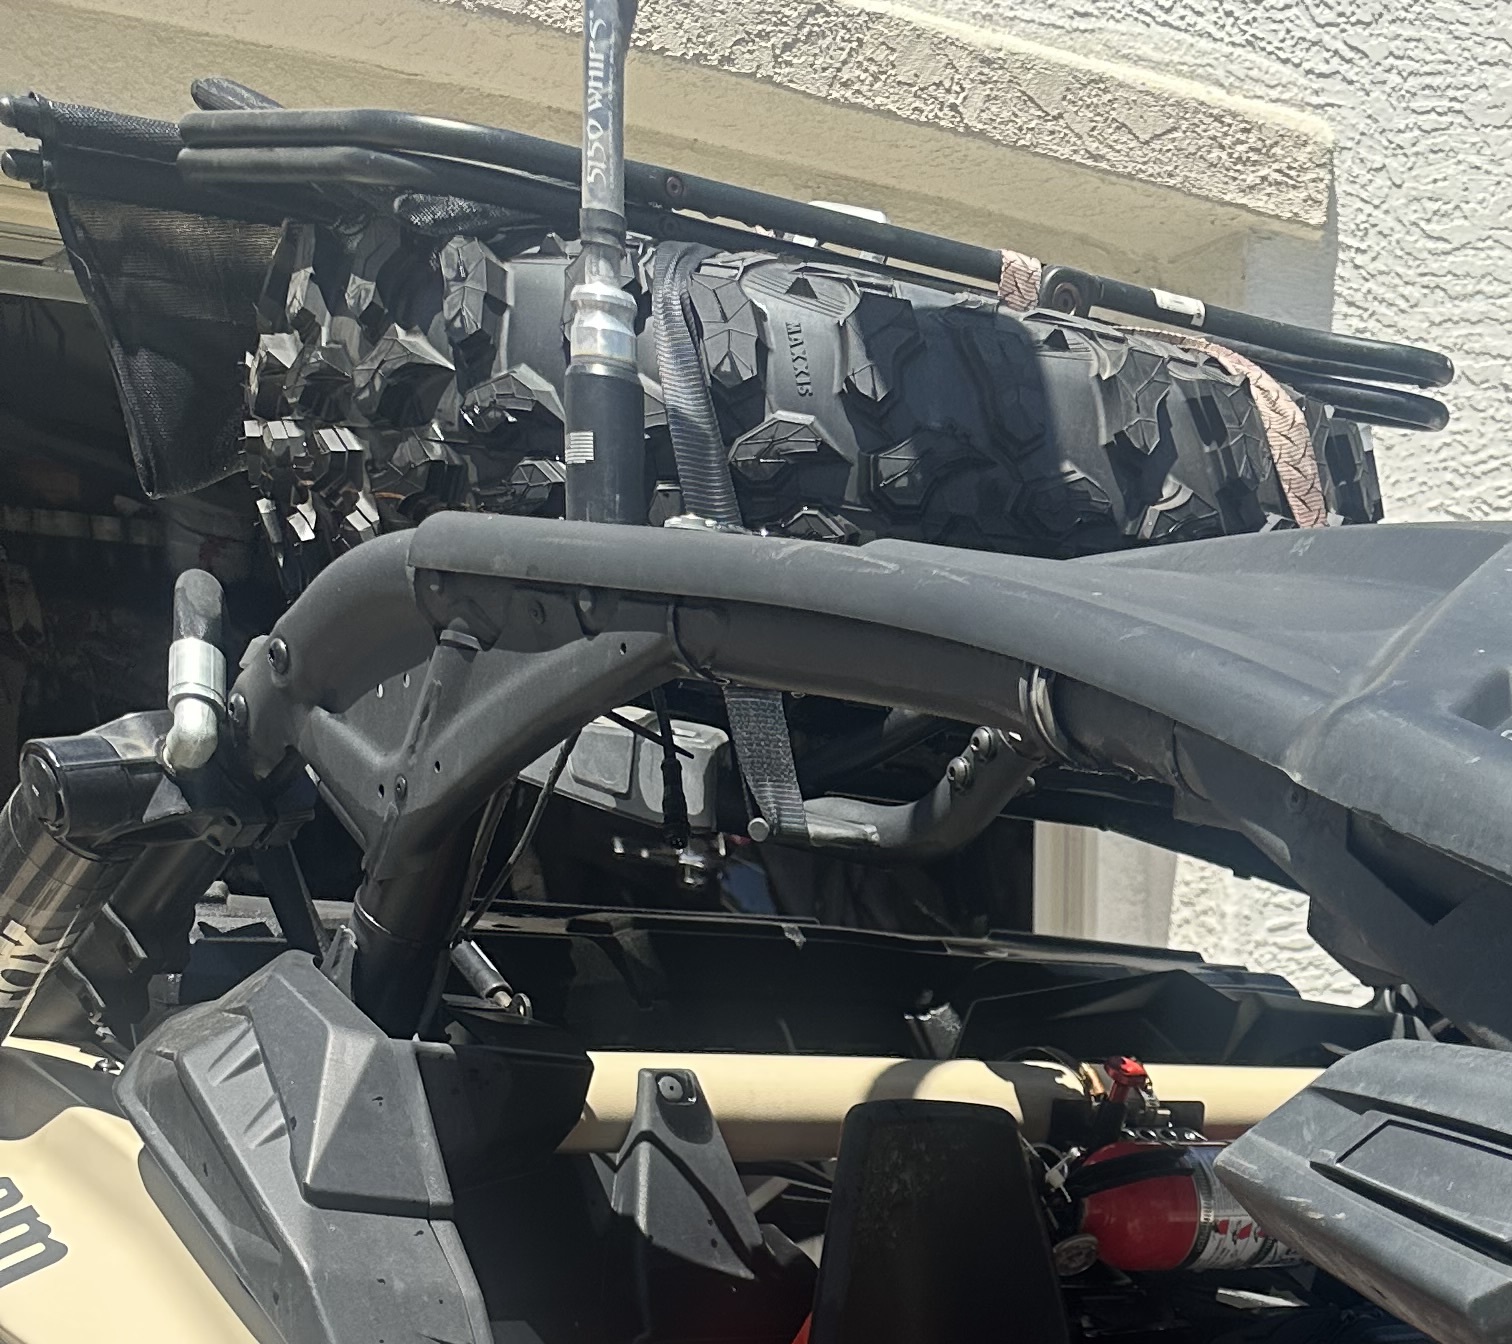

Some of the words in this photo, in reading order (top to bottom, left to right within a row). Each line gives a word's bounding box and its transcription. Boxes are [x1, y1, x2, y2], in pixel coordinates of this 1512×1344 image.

[587, 9, 607, 113] WHIPS
[586, 117, 607, 190] 5150
[785, 321, 813, 397] MAXXIS
